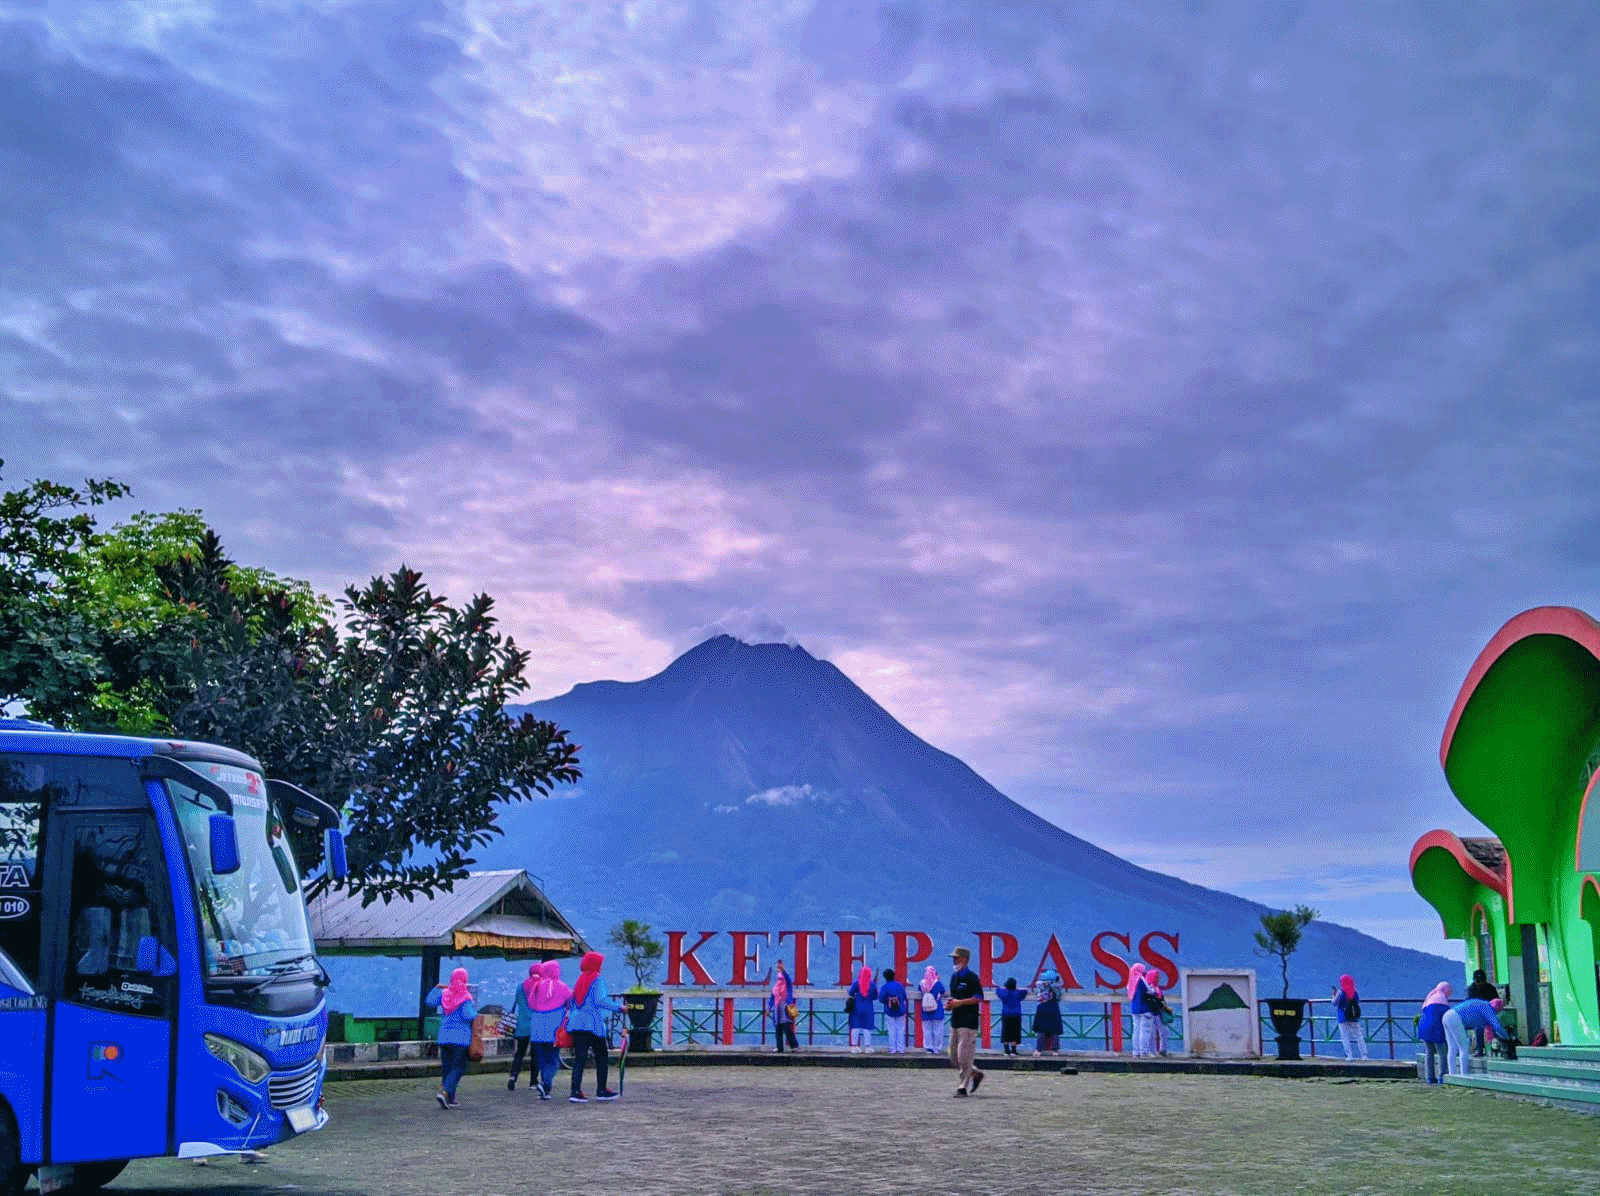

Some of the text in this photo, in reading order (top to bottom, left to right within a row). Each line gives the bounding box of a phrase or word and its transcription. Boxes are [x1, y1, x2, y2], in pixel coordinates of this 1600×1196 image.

[4, 901, 25, 913] 010
[661, 930, 1181, 992] KETEP PASS
